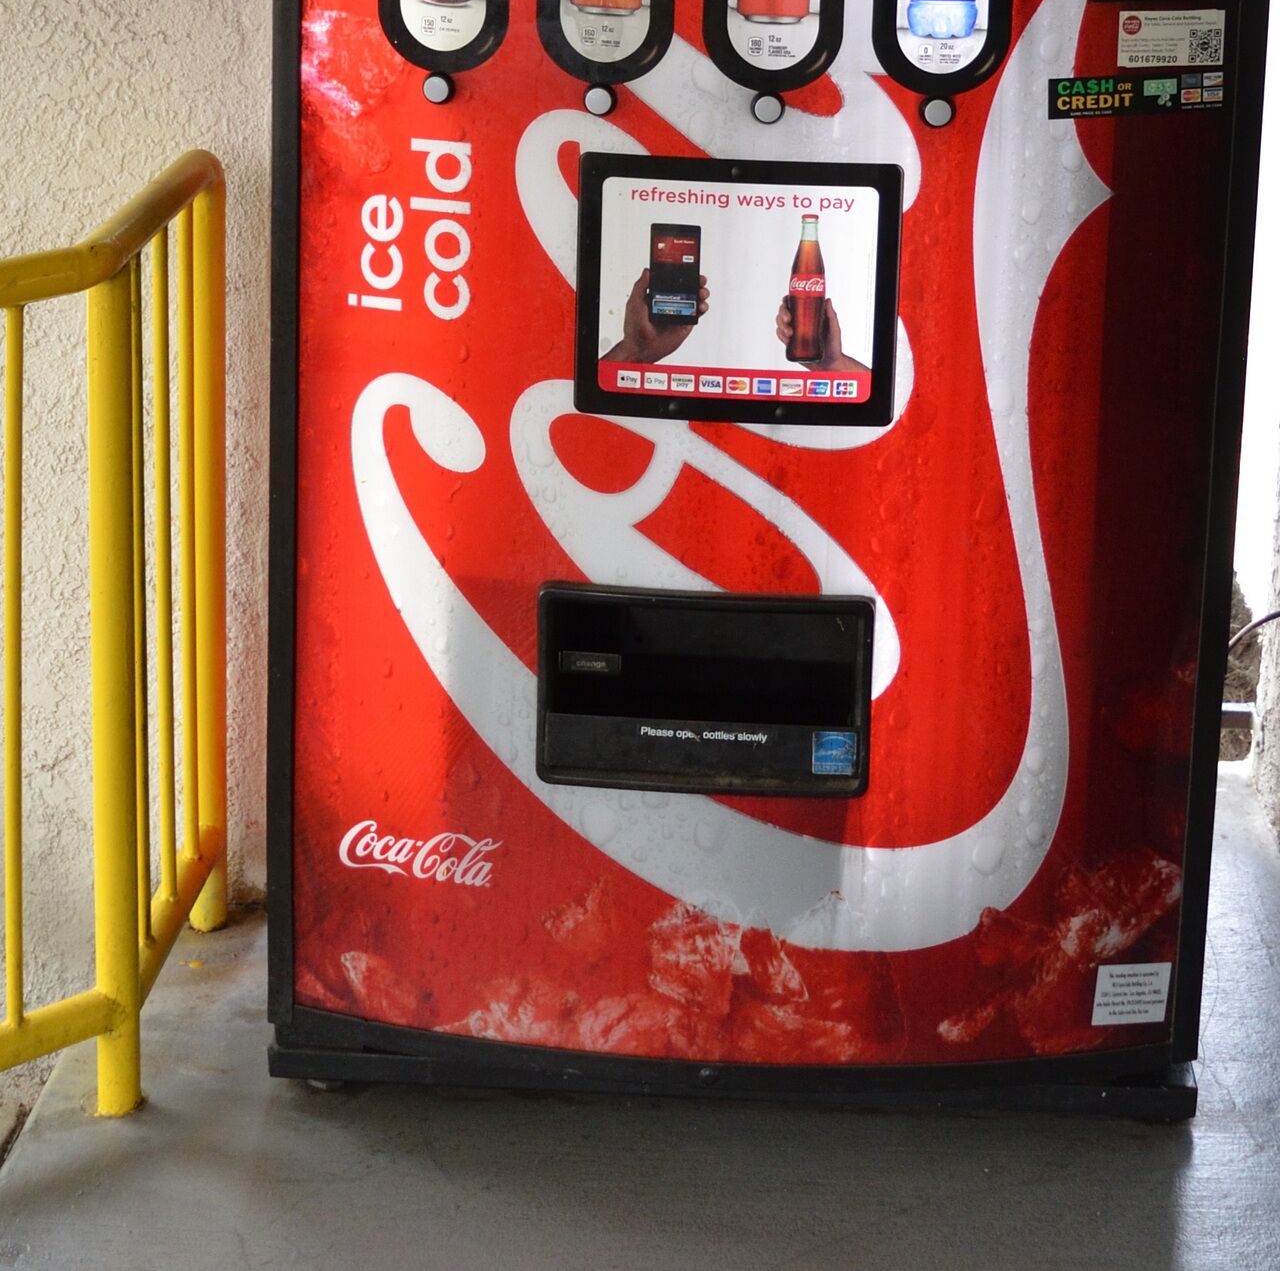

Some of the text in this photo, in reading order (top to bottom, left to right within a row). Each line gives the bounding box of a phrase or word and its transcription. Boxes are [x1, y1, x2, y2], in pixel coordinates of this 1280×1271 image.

[924, 46, 928, 54] 0
[940, 42, 948, 50] 20
[1128, 55, 1177, 63] 601679920
[1056, 79, 1132, 96] CASH OR
[1056, 93, 1134, 111] CREDIT
[630, 186, 855, 213] refreshing ways to pay
[410, 137, 472, 320] cold
[347, 194, 404, 312] ice
[789, 278, 825, 292] Coca-Cola
[702, 380, 720, 388] VISA
[836, 382, 854, 395] JCB
[640, 726, 674, 737] Please
[676, 730, 700, 740] ope
[737, 732, 767, 744] slowly
[338, 820, 504, 887] Coca-Cola
